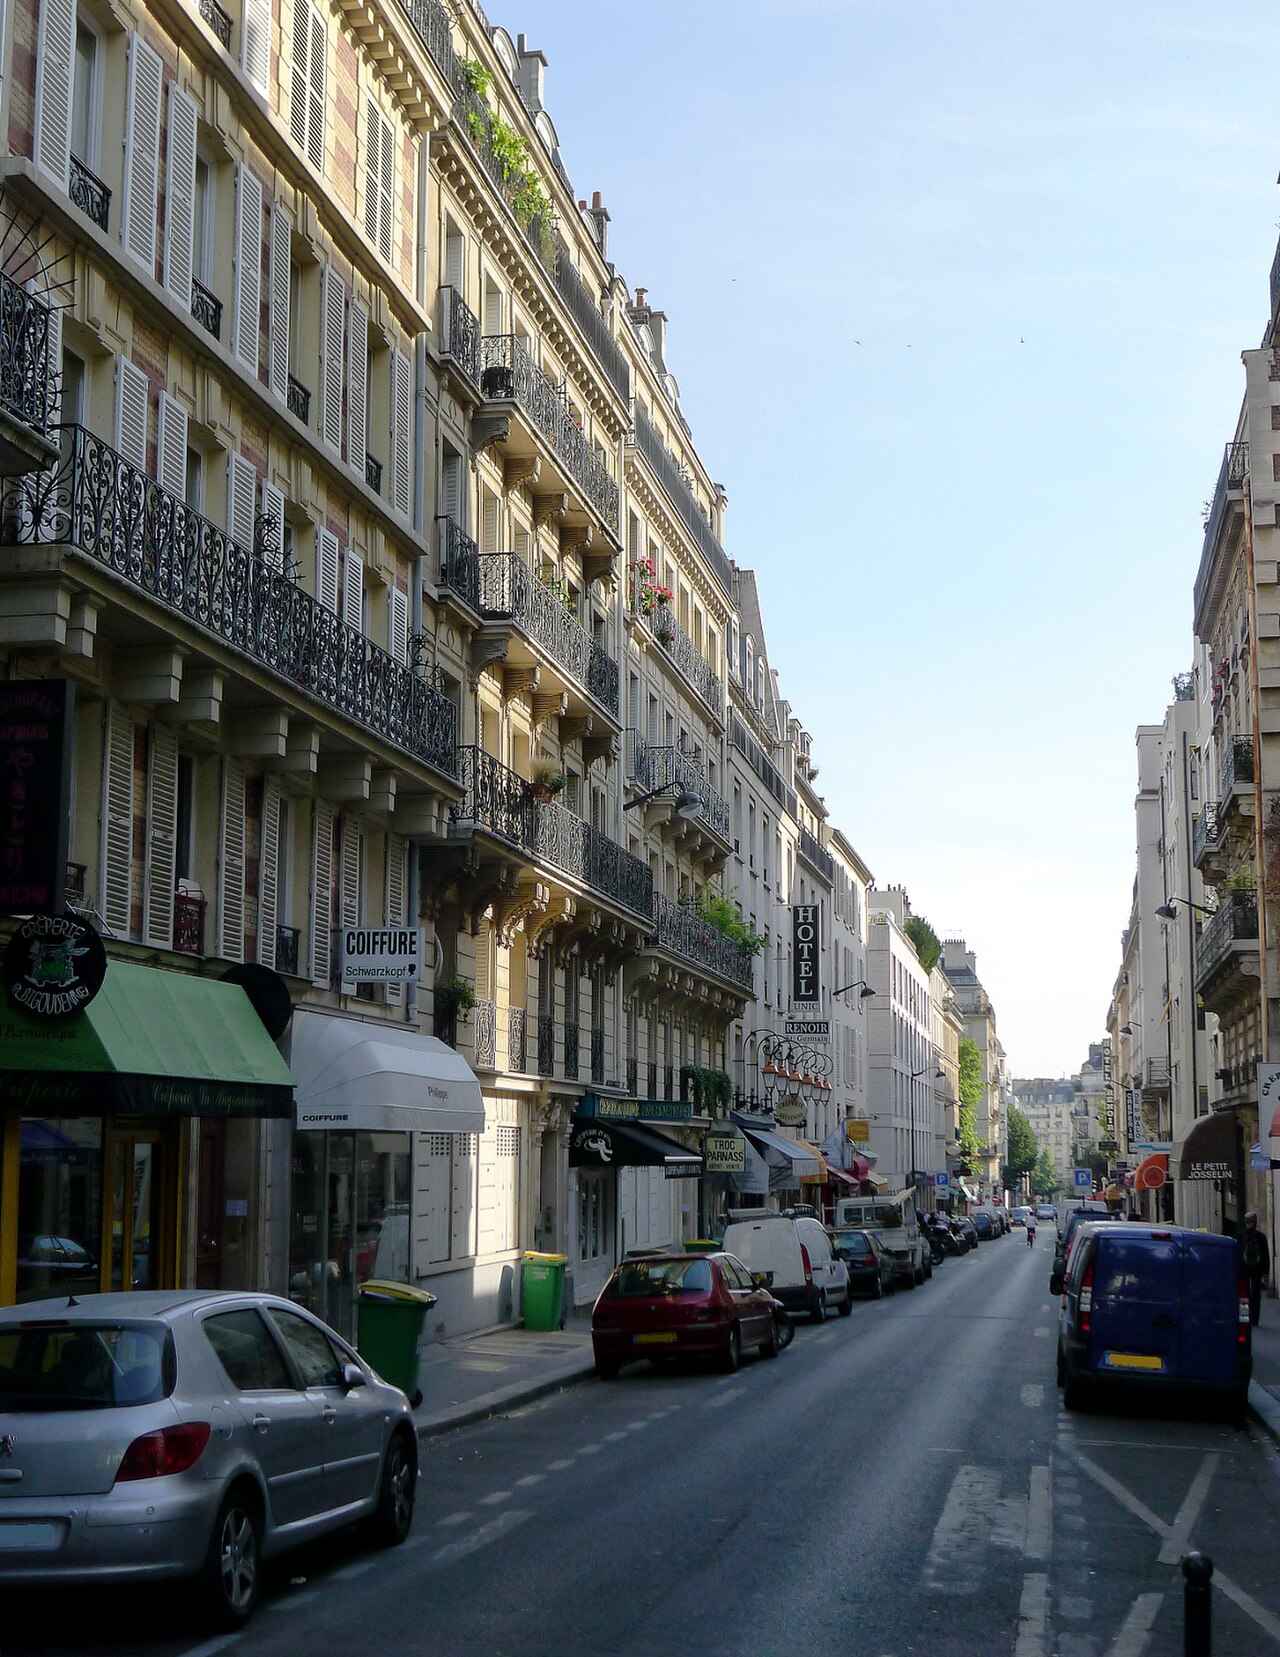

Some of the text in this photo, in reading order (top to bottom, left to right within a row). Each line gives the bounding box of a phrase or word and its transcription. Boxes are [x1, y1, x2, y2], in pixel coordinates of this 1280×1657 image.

[346, 931, 417, 955] COIFFURE
[796, 906, 815, 996] HOTEL
[345, 965, 407, 978] Schwarzkopf
[793, 1002, 819, 1010] UNIC
[786, 1022, 828, 1033] RENOIR
[1103, 1040, 1111, 1081] HOTEL
[302, 1114, 349, 1122] COIFFURE
[714, 1140, 736, 1150] TROC
[707, 1151, 744, 1162] PARNASS
[1191, 1163, 1229, 1171] LE PETIT
[938, 1174, 946, 1183] P
[1078, 1173, 1087, 1184] P
[1187, 1171, 1232, 1179] JOSSELIN
